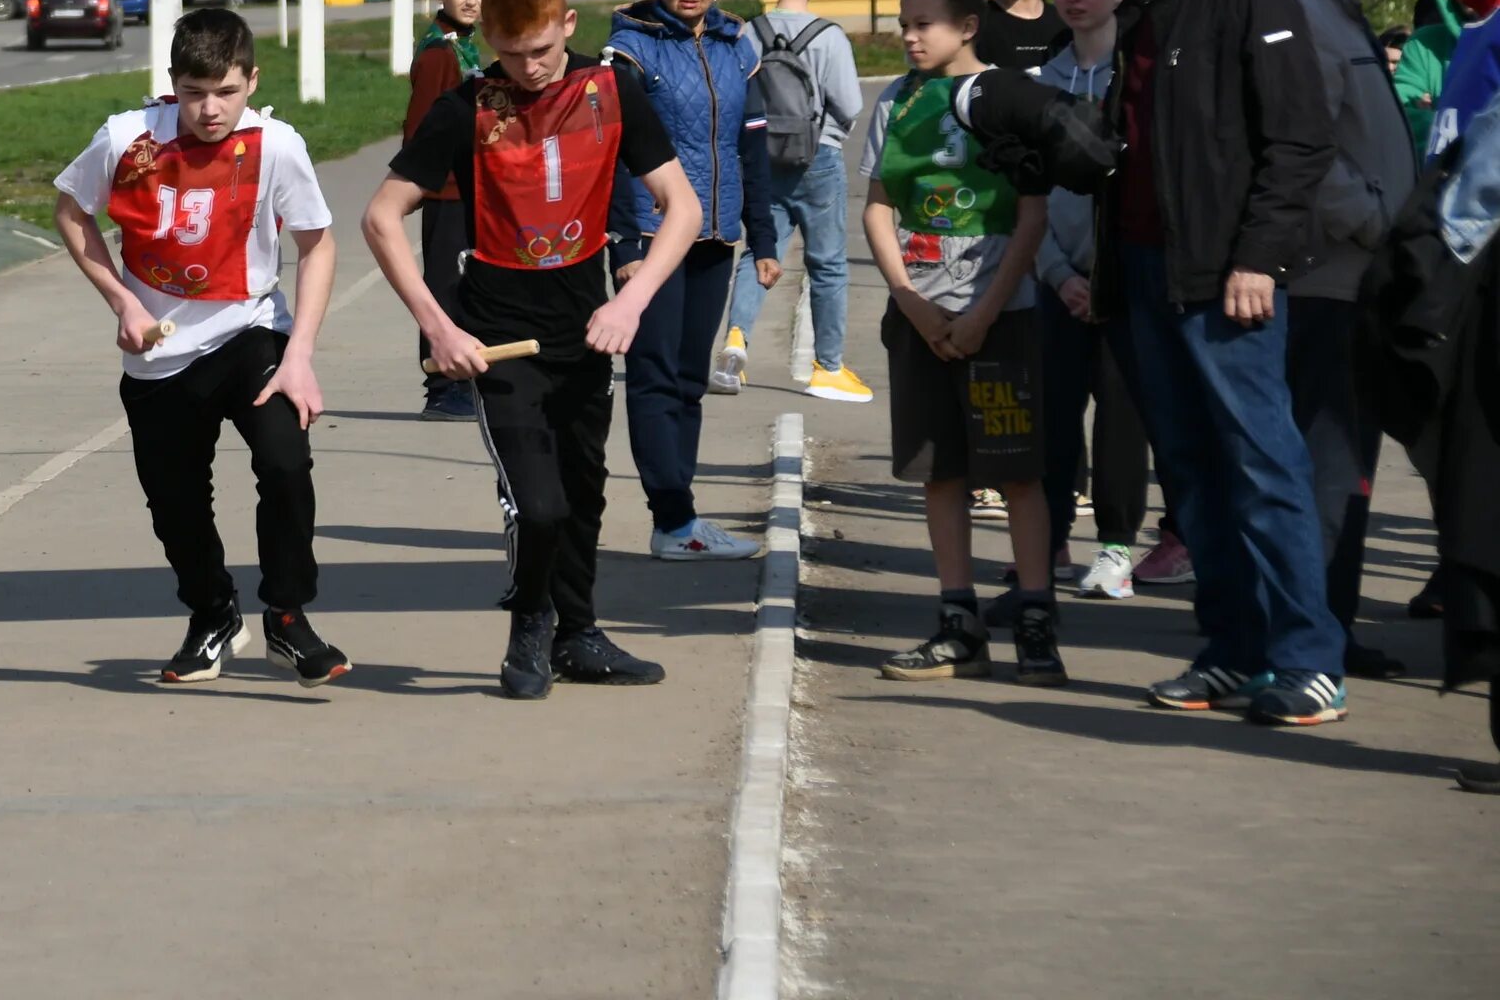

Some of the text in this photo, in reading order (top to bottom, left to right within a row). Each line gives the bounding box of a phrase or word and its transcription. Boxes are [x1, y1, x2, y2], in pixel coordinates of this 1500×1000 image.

[932, 111, 968, 168] 3
[542, 135, 563, 202] 1
[153, 184, 214, 245] 13
[969, 382, 1018, 408] REAL
[983, 408, 1033, 436] ISTIC
